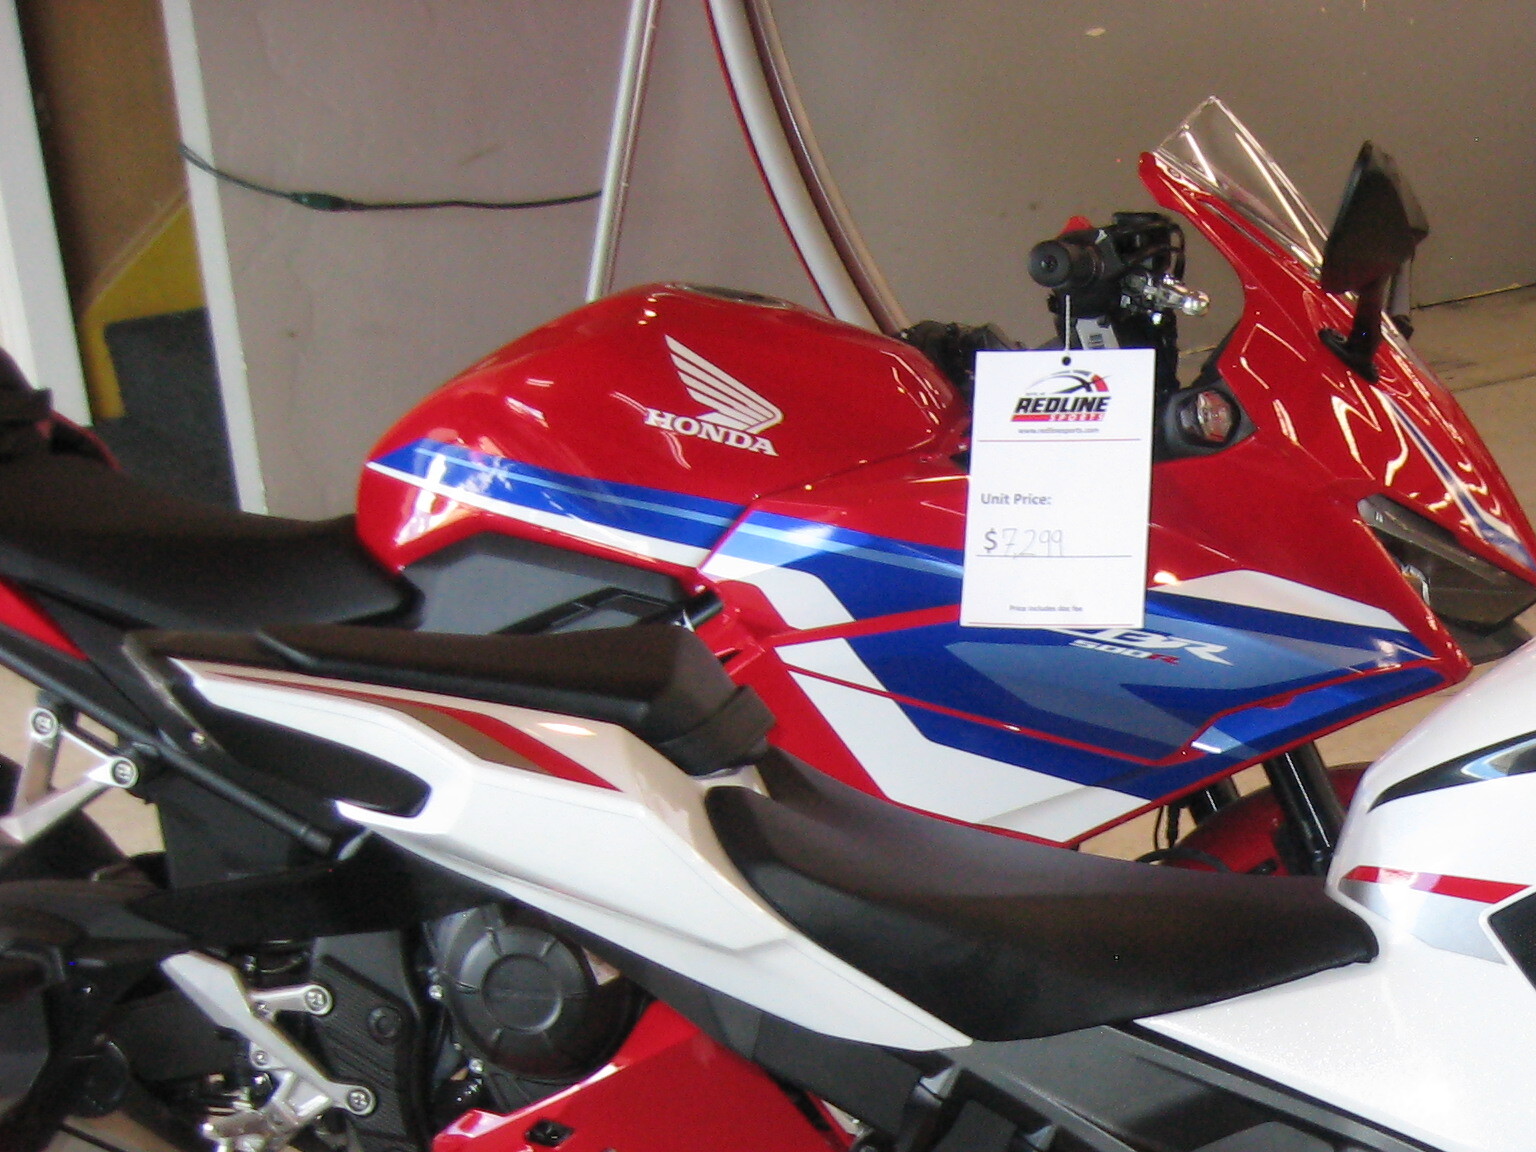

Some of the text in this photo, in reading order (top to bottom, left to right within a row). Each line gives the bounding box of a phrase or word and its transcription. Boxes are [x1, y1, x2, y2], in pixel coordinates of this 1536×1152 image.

[1014, 396, 1111, 414] REDLINE
[1048, 413, 1106, 422] SPORTS
[644, 408, 779, 456] HONDA
[980, 493, 1053, 505] Unit Price:
